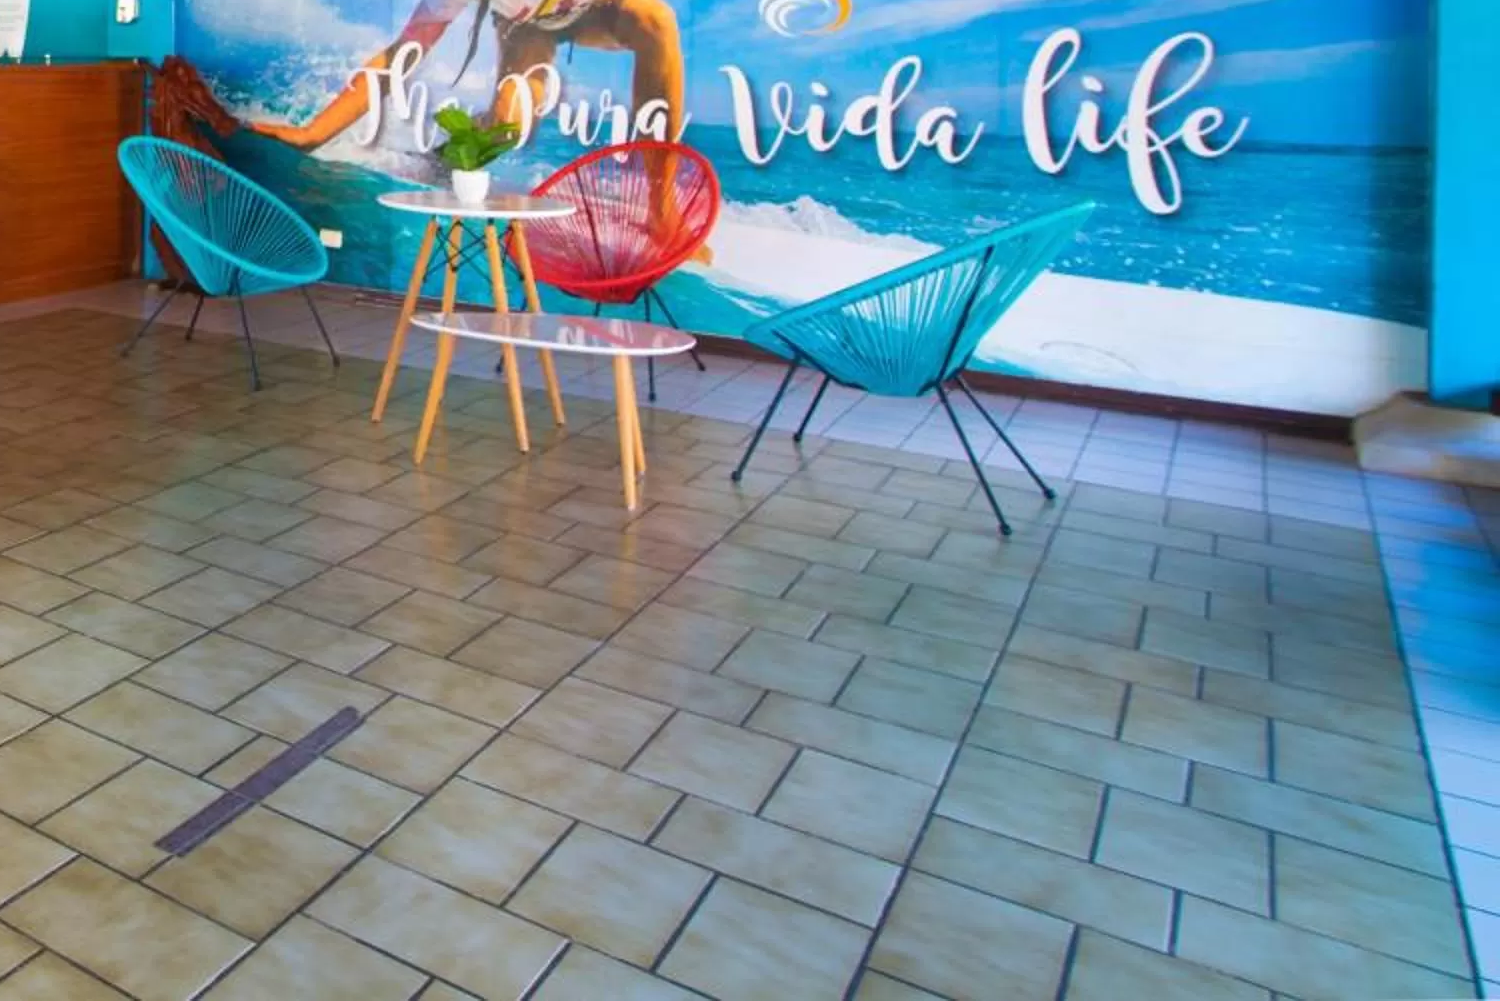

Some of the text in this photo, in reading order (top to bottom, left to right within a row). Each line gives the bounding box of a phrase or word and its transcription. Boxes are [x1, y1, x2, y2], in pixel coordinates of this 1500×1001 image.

[347, 27, 1249, 215] Th Pura Vida life
